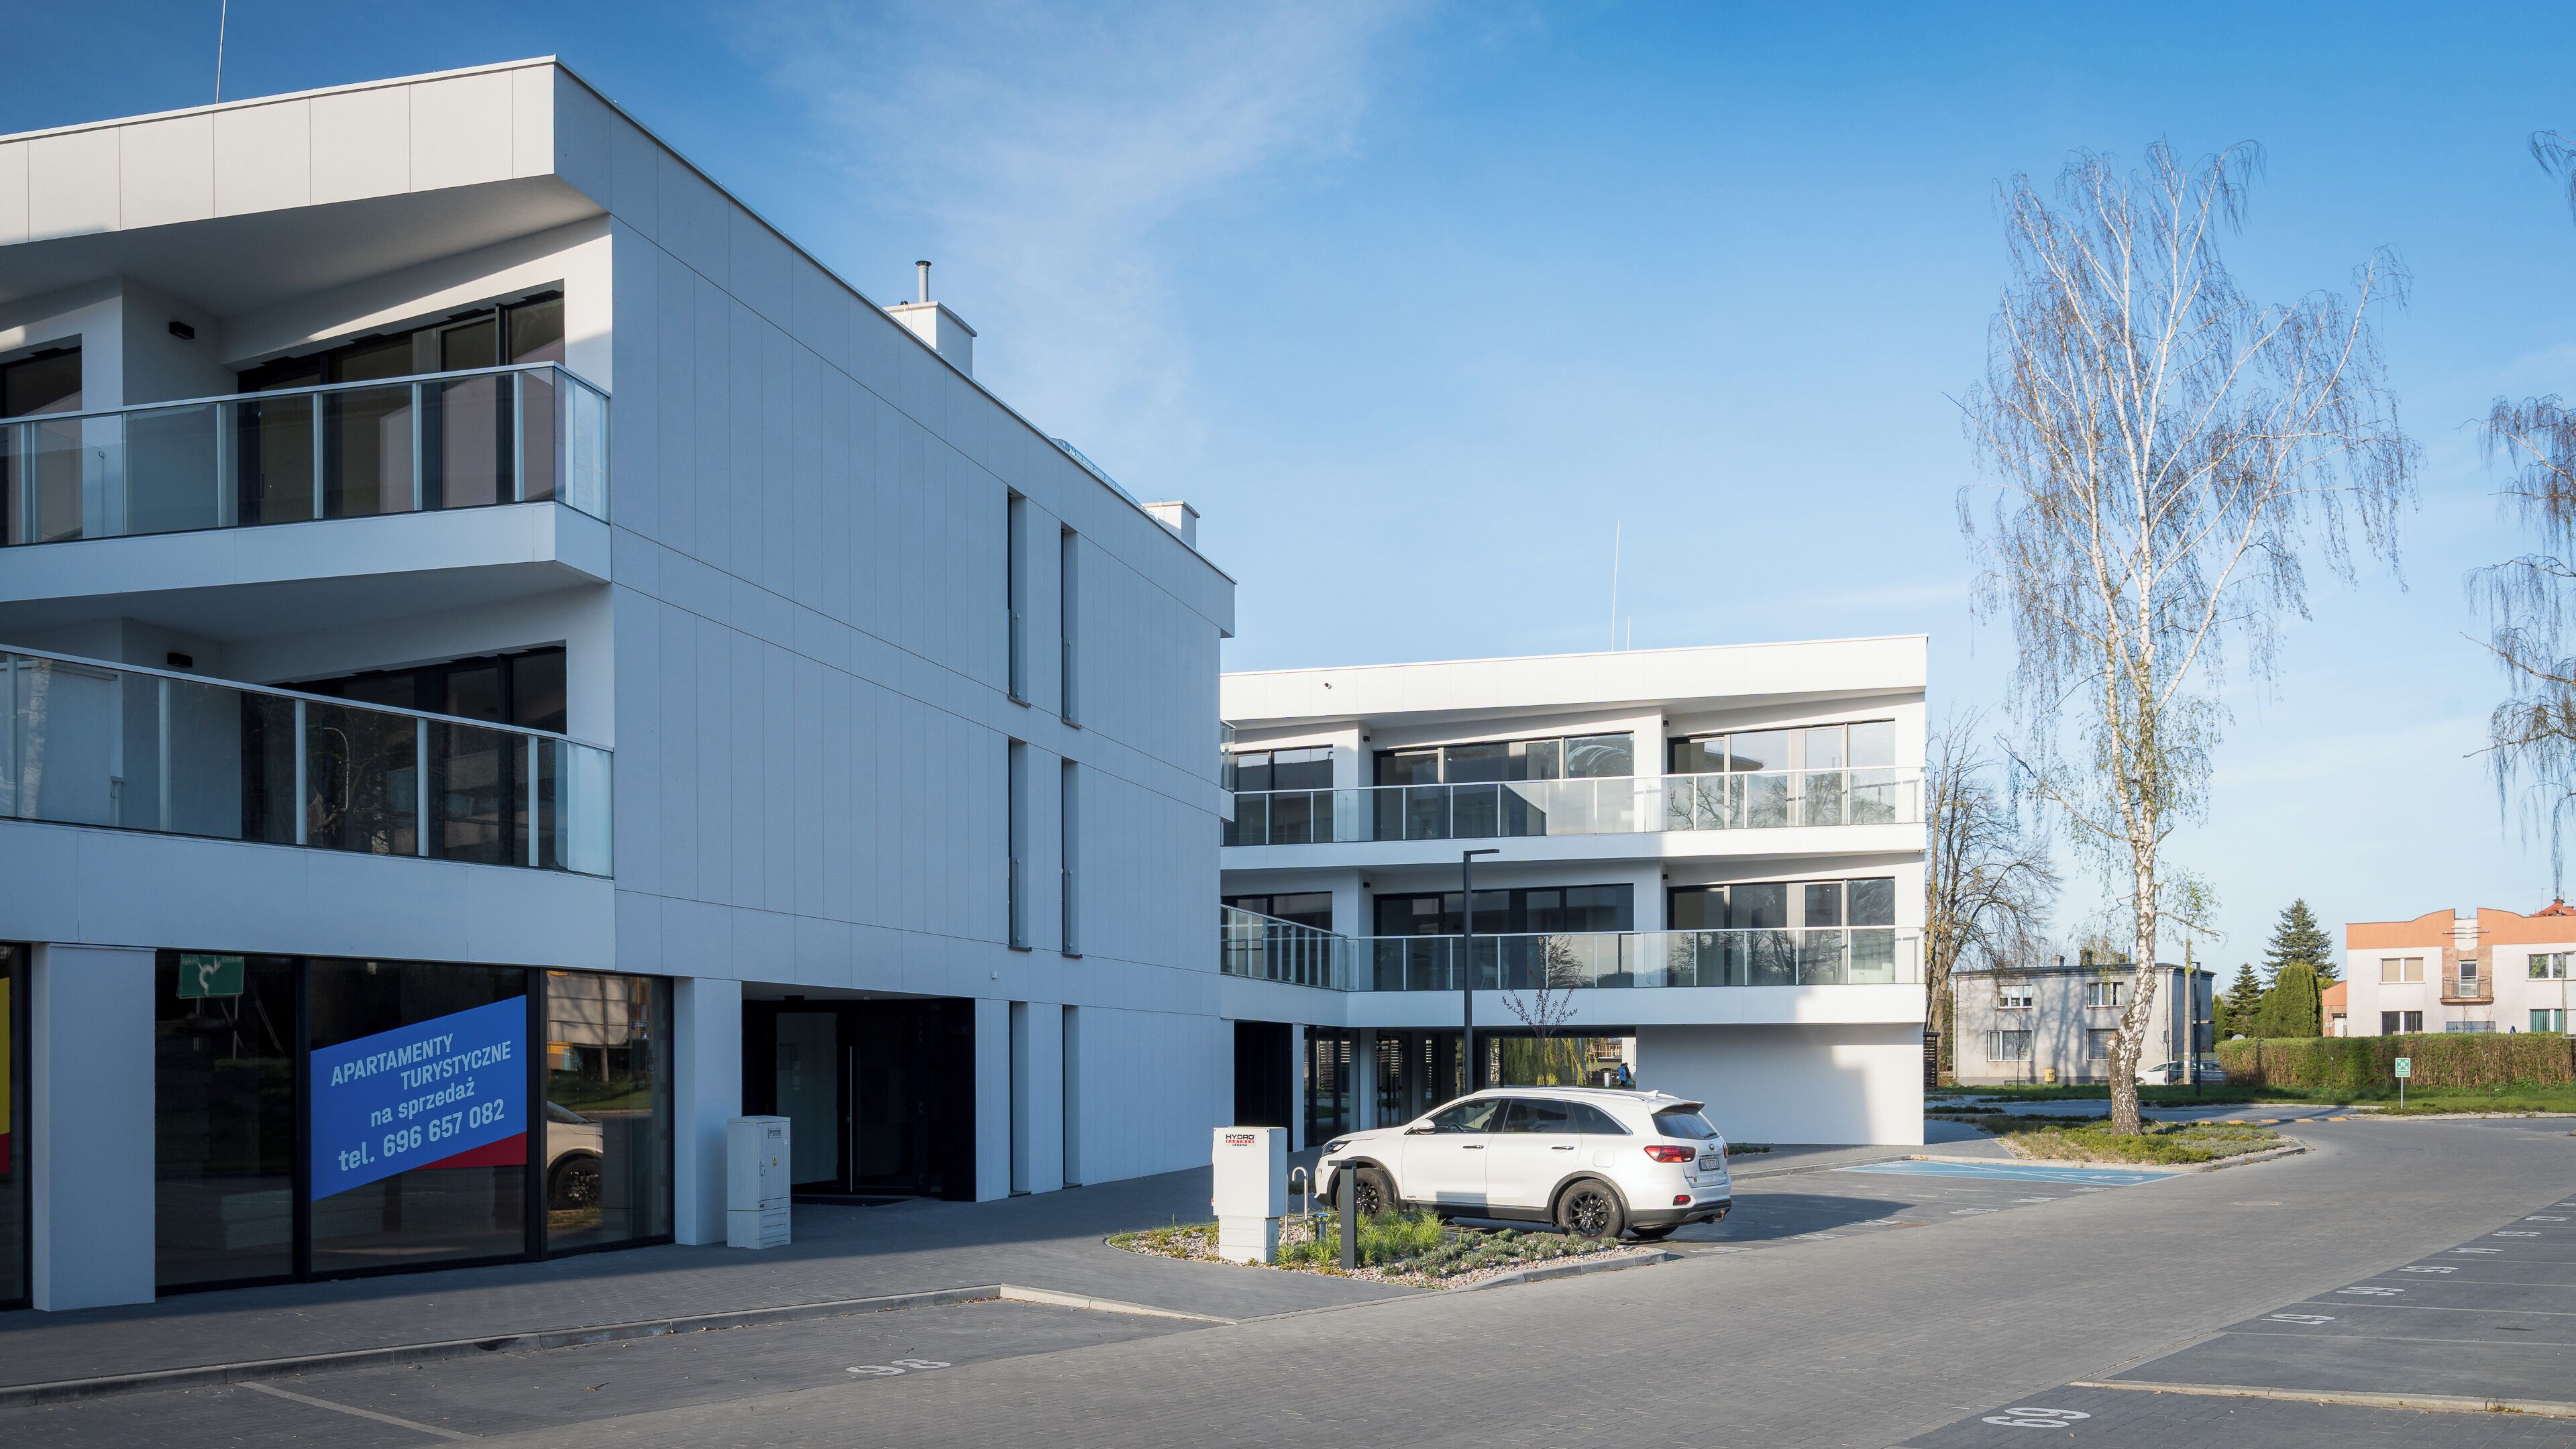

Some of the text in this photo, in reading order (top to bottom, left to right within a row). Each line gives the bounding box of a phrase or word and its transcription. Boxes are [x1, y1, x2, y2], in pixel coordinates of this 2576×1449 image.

[331, 1033, 453, 1087] APARTAMENTY
[400, 1040, 511, 1090] TURYSTYCZNE
[371, 1077, 475, 1128] na sprzedaż
[338, 1099, 504, 1171] tel. 696 657 082
[2336, 1287, 2405, 1295] 66
[2261, 1313, 2336, 1325] 67
[846, 1359, 951, 1375] 98
[1982, 1407, 2091, 1428] 69
